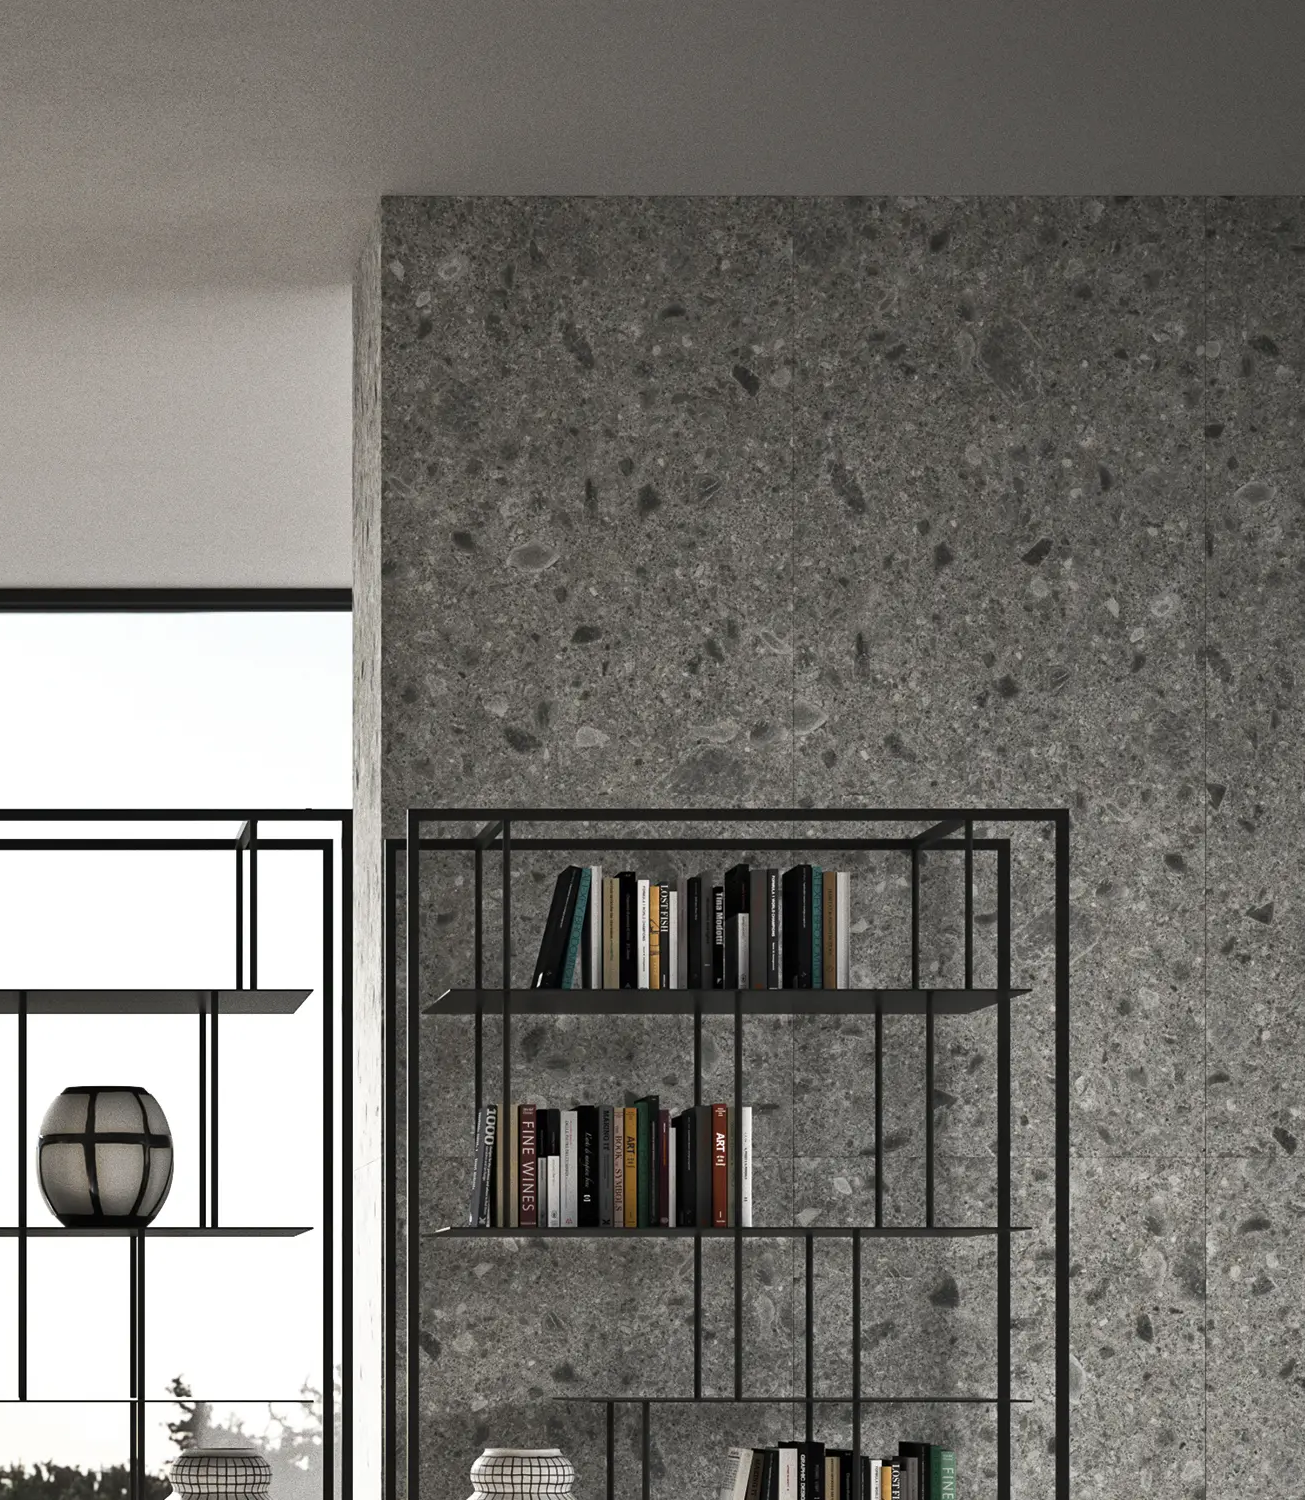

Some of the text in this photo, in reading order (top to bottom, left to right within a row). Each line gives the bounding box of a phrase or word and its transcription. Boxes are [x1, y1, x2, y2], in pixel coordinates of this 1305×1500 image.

[660, 885, 668, 932] LOST FISH
[715, 892, 723, 945] Tina Modotti
[484, 1108, 496, 1145] 1000
[603, 1143, 609, 1151] IT
[627, 1136, 635, 1154] ART
[716, 1133, 725, 1152] ART
[522, 1121, 534, 1211] FINE WINES
[892, 1465, 900, 1489] LOST
[942, 1468, 953, 1499] FINE
